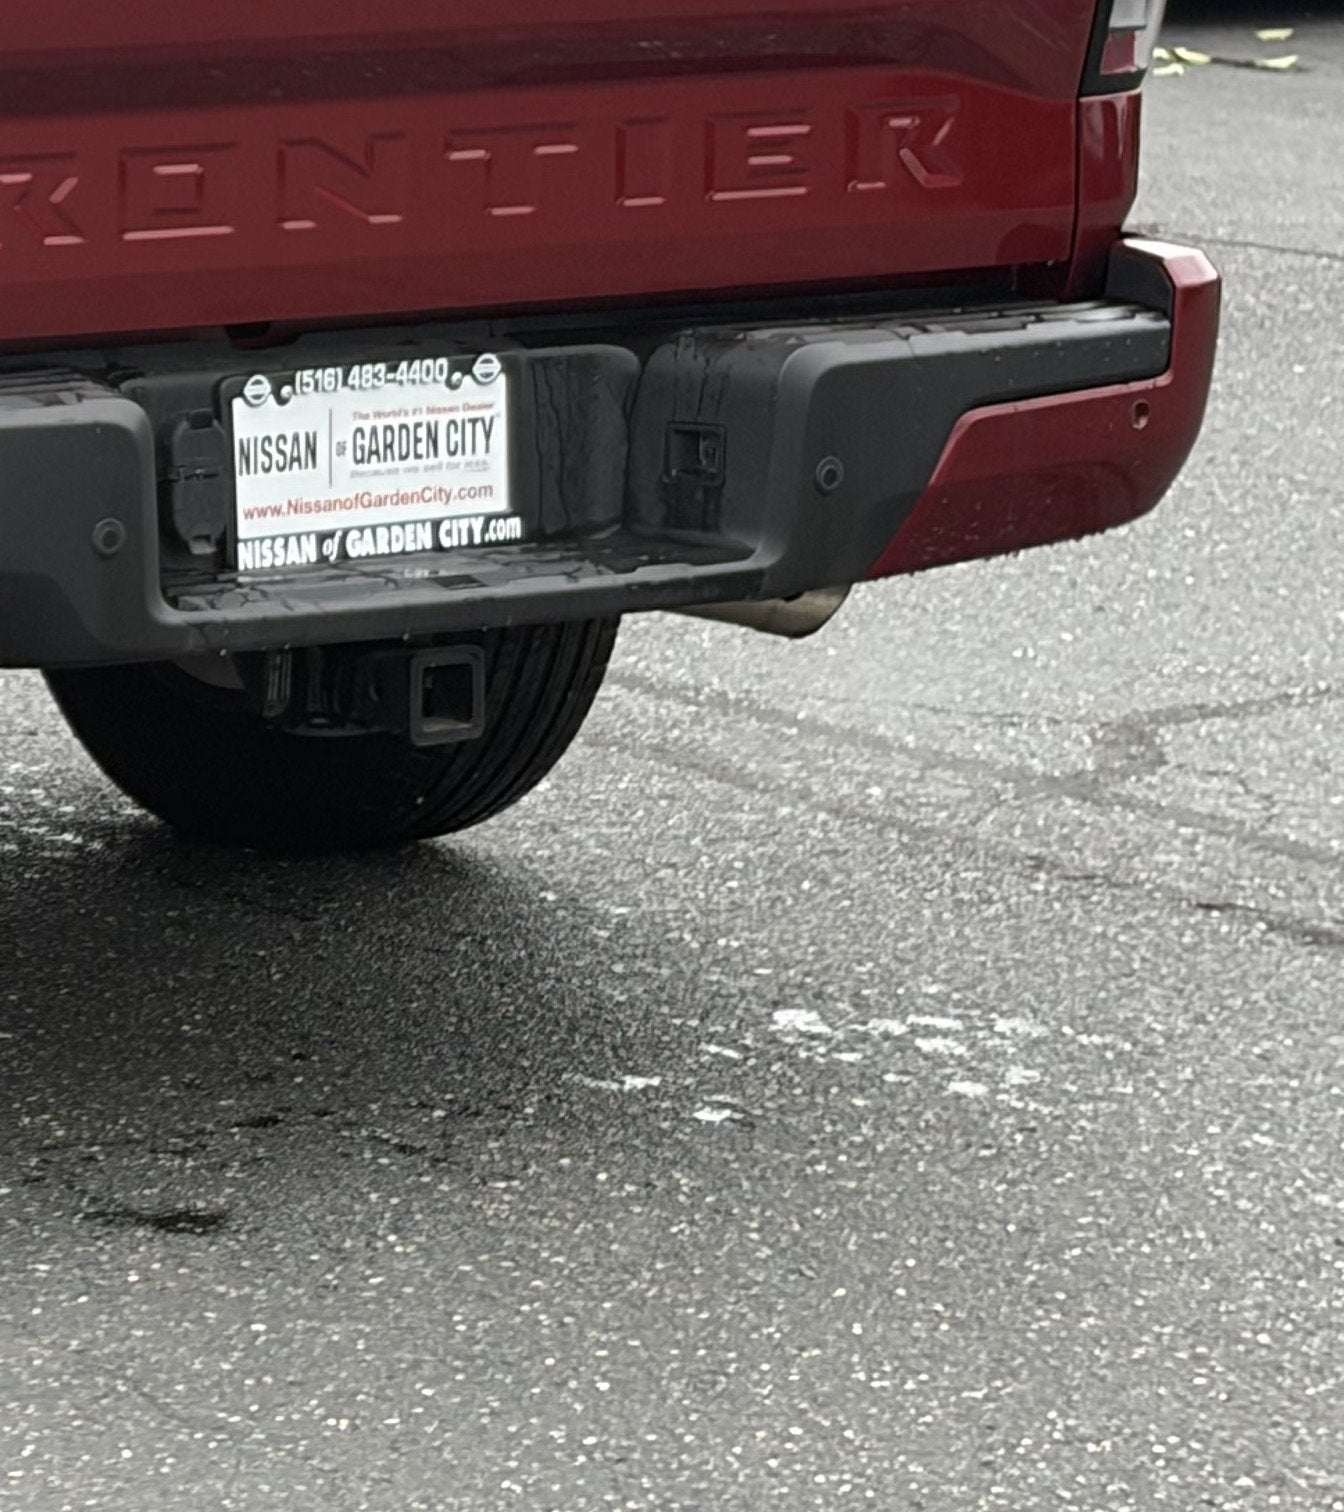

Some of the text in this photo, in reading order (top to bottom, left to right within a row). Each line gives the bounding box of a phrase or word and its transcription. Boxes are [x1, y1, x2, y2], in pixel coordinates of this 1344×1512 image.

[295, 357, 448, 396] (516) 483-4400
[238, 430, 318, 476] NISSAN
[352, 420, 439, 465] GARDEN
[445, 415, 495, 457] CITY
[242, 484, 494, 520] www.NissanofGardenCity.com
[238, 516, 522, 572] NISSAN of GARDEN CITY.com
